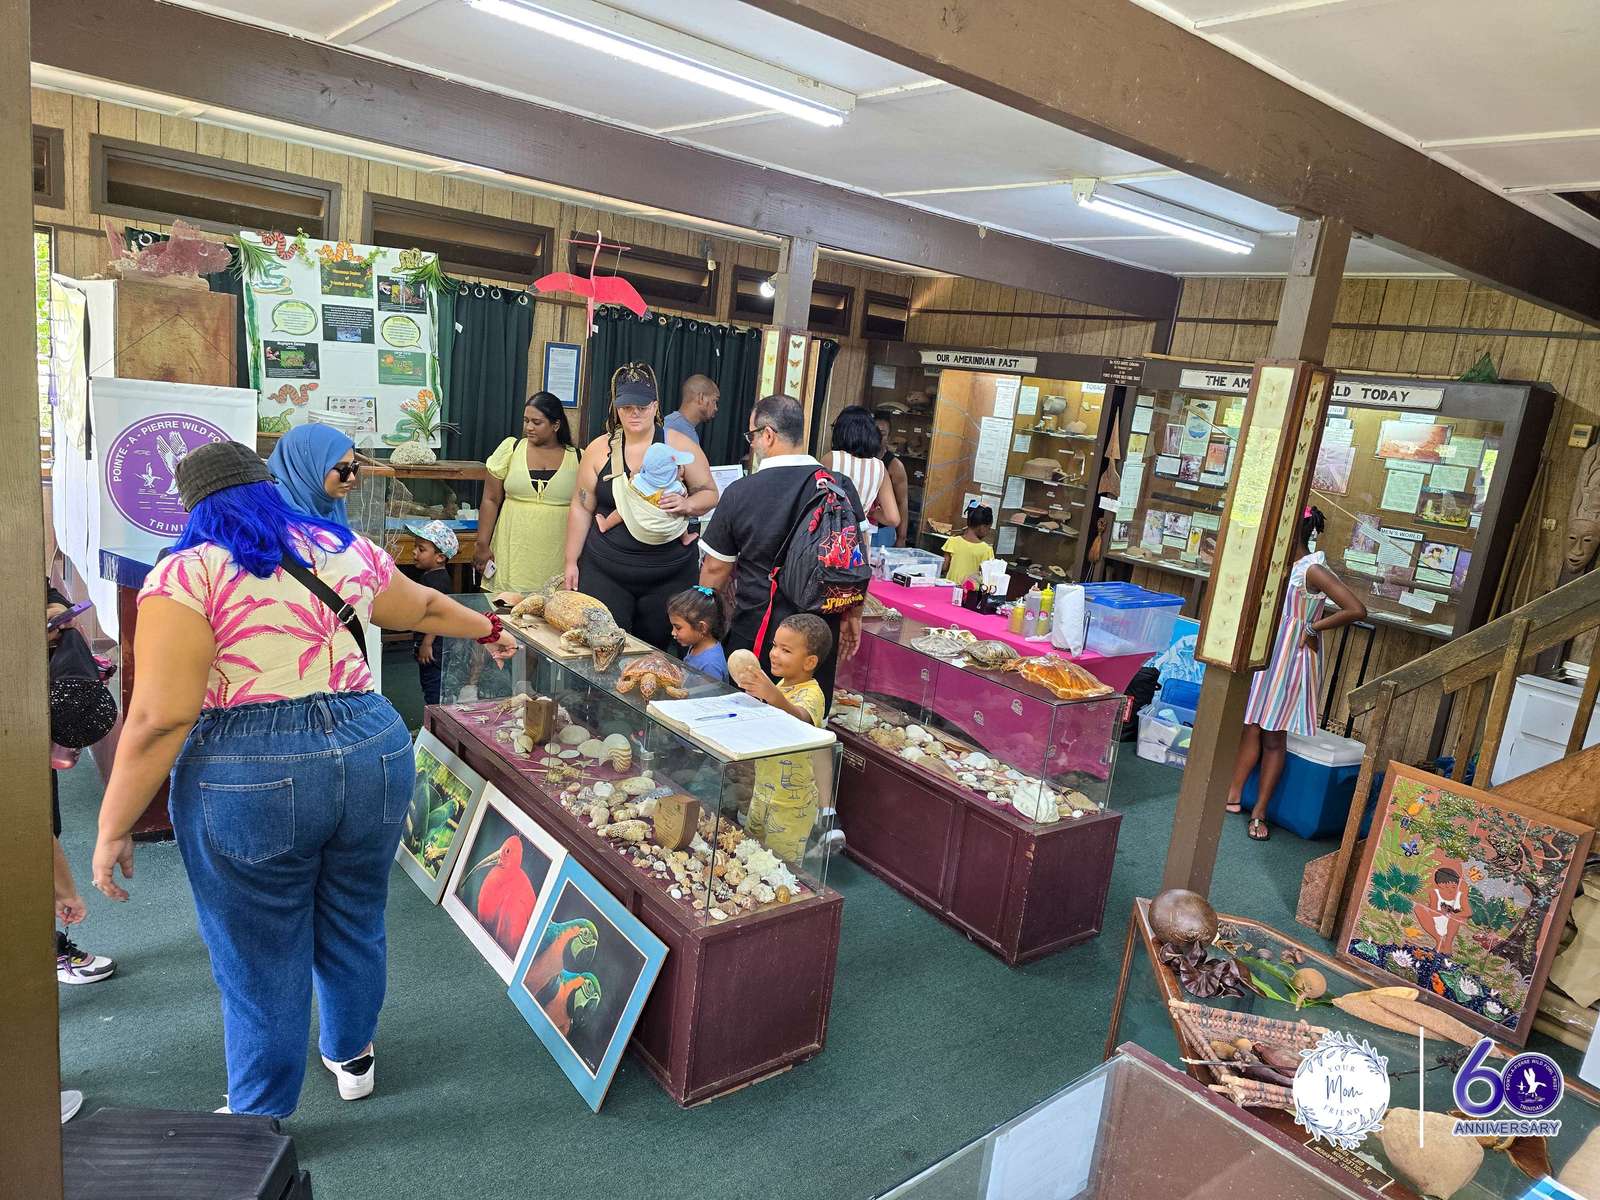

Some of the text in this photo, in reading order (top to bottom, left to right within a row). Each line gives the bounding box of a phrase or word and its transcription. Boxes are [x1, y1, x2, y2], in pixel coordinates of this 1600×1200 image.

[936, 353, 1020, 368] OUR AMERINDIAN PAST
[1205, 375, 1228, 387] THE
[1361, 387, 1410, 402] TODAY
[113, 447, 128, 482] POINTE
[141, 420, 180, 436] PIERRE
[182, 421, 207, 435] WILD
[208, 432, 222, 444] FO
[149, 518, 185, 532] TRINI
